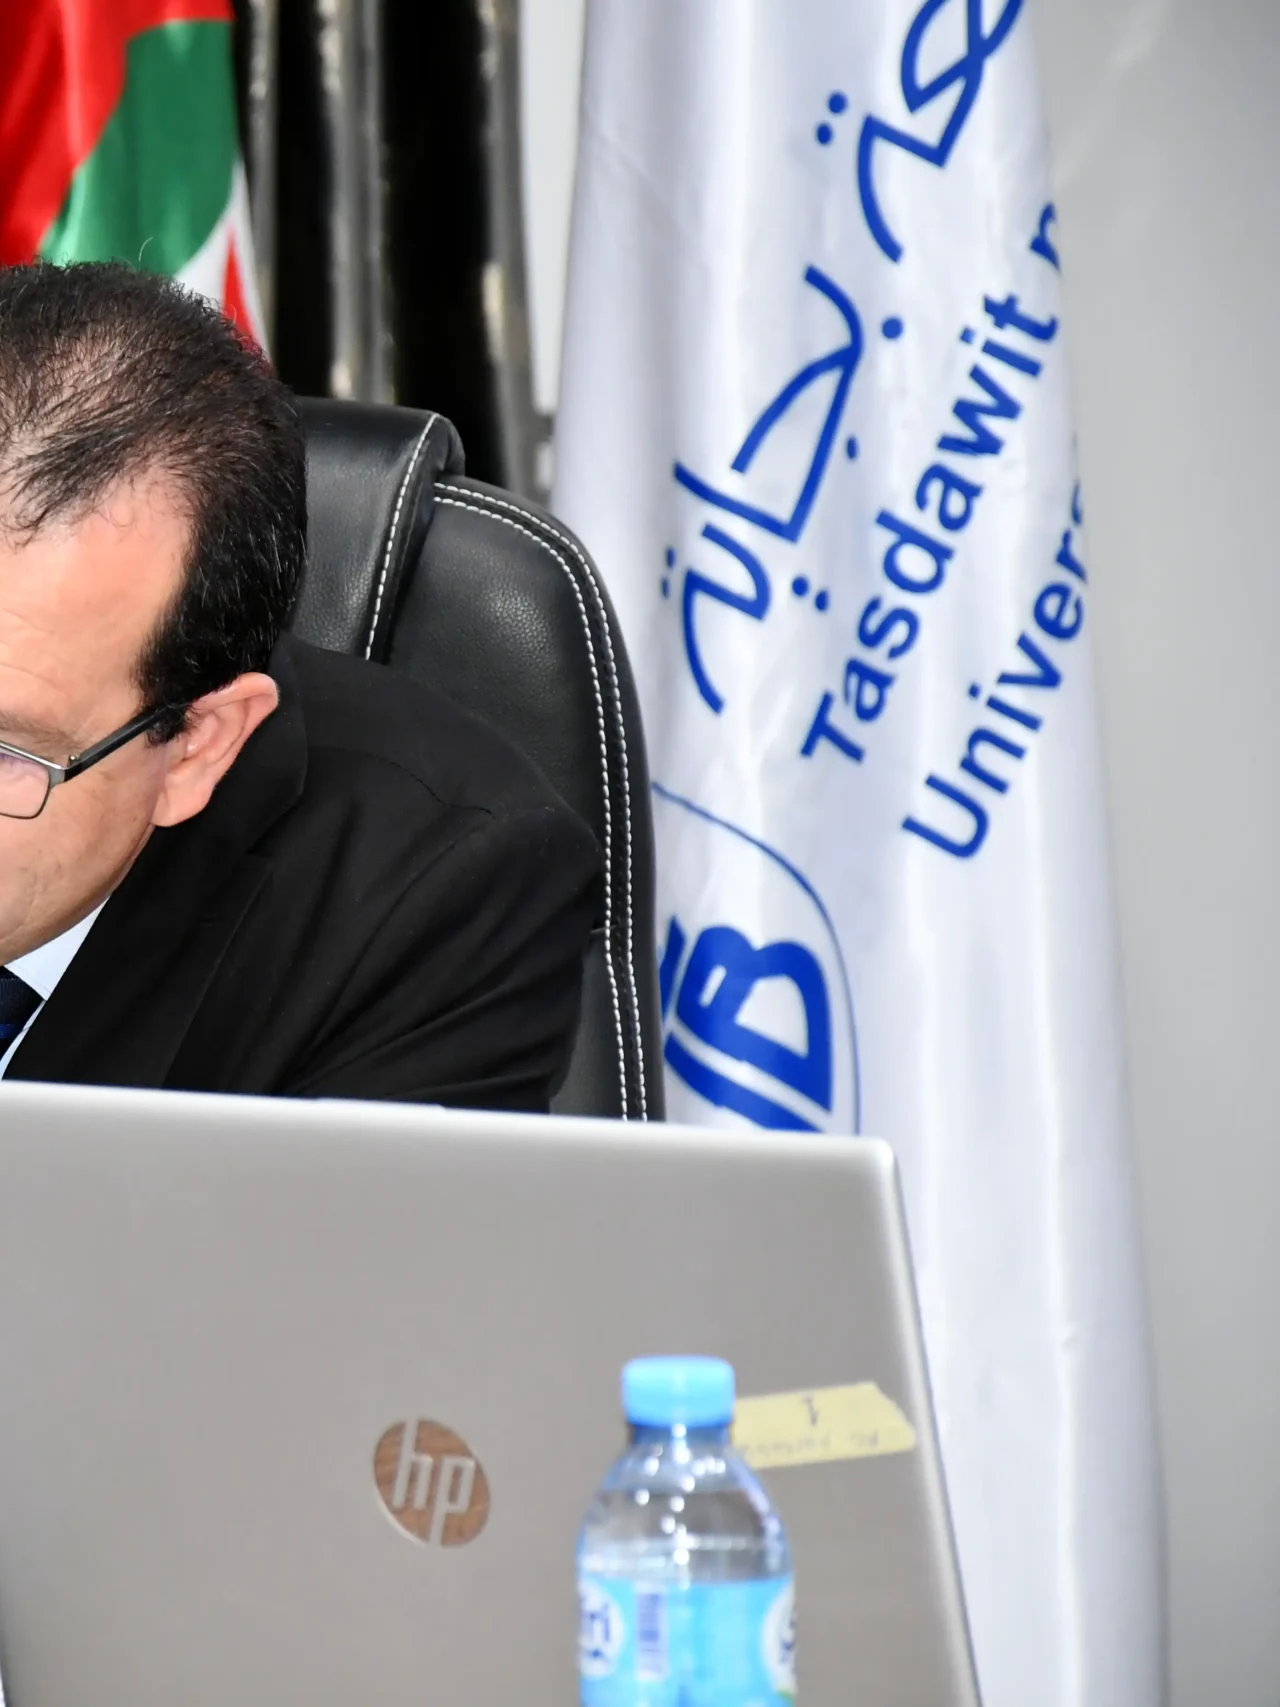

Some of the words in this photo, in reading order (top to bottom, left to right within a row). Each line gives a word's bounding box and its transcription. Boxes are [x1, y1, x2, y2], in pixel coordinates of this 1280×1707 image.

[661, 265, 905, 714] بجاية
[800, 294, 1059, 763] Tasdawit
[901, 482, 1087, 860] Univer
[391, 1417, 477, 1546] hp
